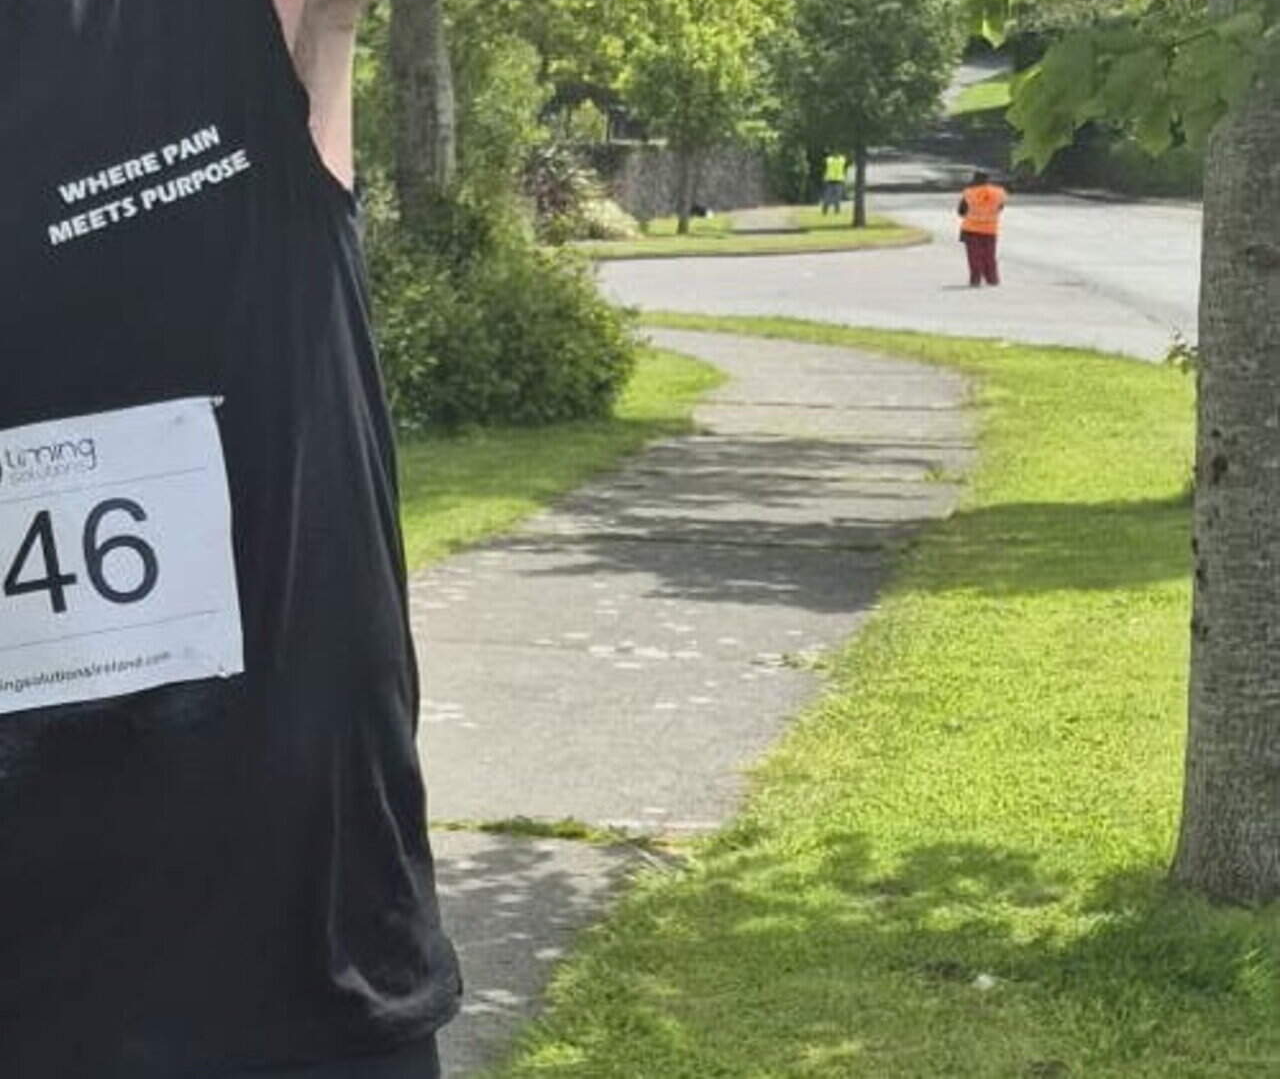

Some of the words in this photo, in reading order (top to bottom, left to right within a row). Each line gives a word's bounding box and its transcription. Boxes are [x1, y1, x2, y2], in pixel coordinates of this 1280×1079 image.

[47, 196, 138, 245] MEETS
[140, 149, 251, 210] PURPOSE
[58, 152, 161, 204] WHERE
[161, 124, 221, 166] PAIN
